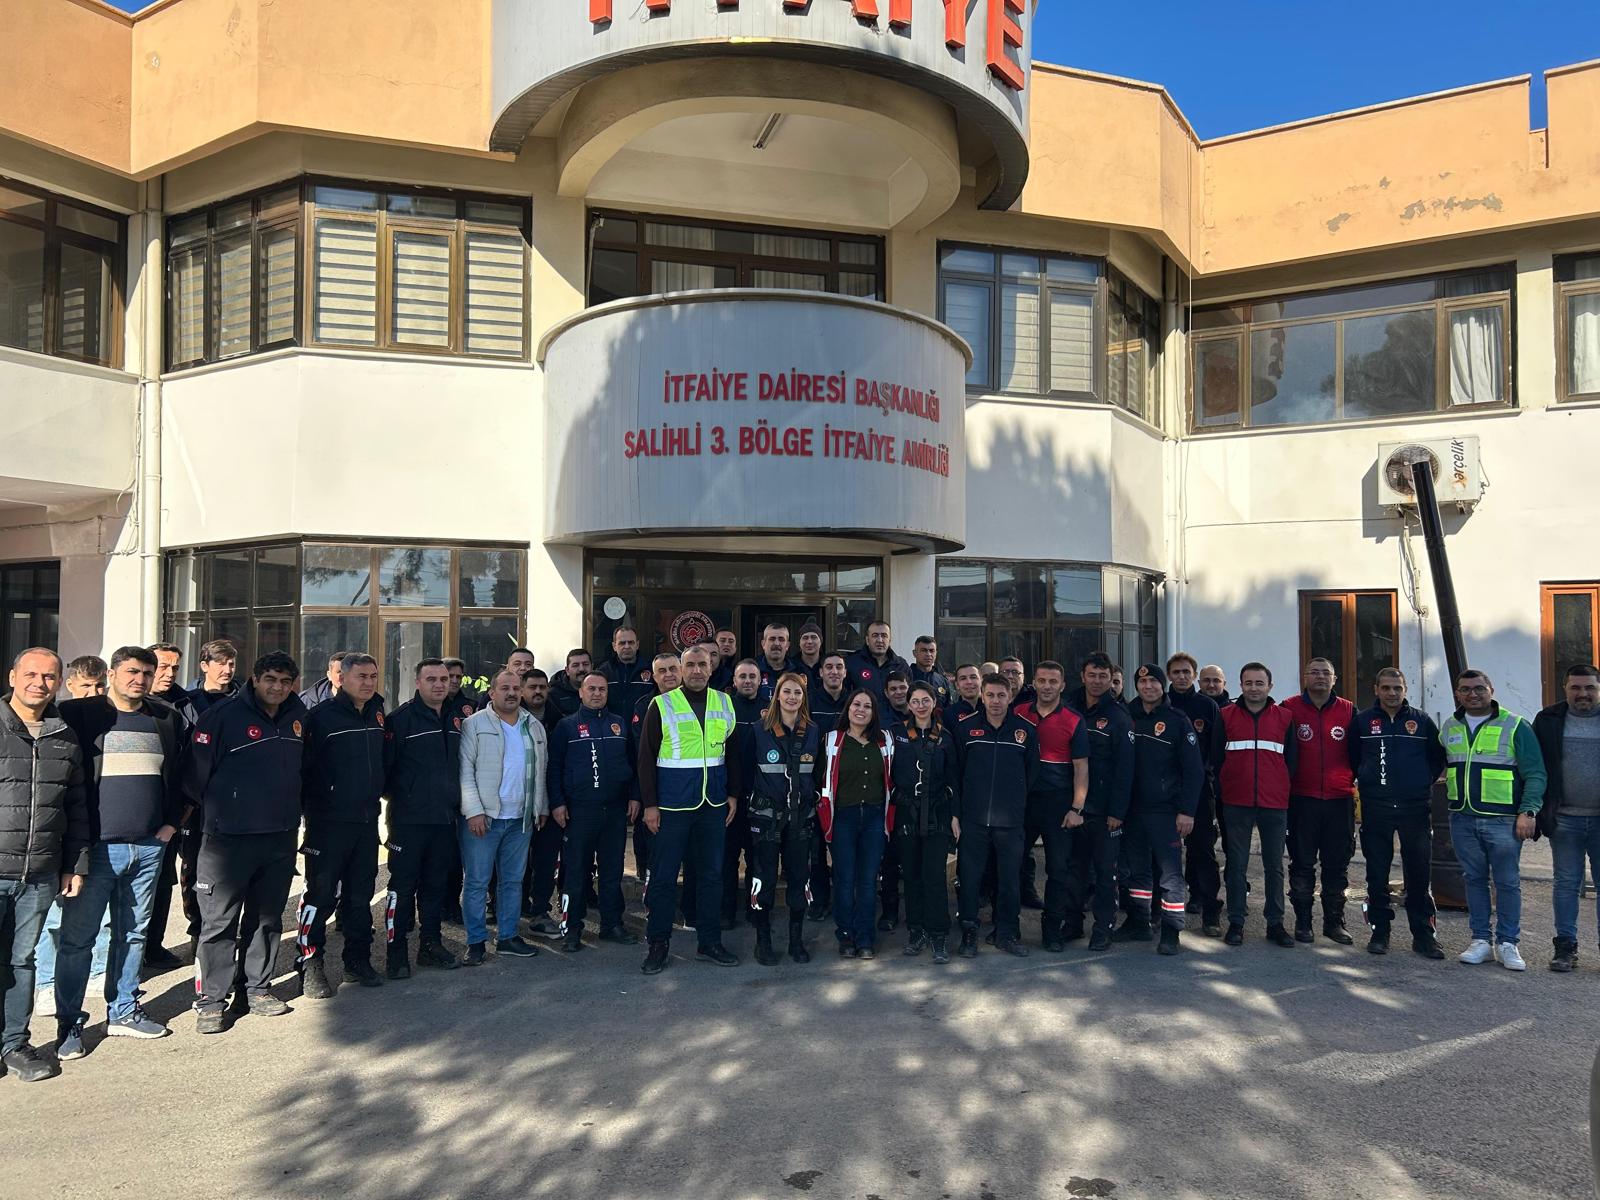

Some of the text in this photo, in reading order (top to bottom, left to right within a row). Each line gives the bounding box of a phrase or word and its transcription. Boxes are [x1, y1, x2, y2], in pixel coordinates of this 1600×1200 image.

[664, 367, 940, 423] İTFAİYE DAİRESİ BAŞKANLIĞI
[624, 419, 950, 478] SALİHLİ 3. BÖLGE İTFAİYE AMİRLİĞİ
[1450, 440, 1467, 481] arçelik
